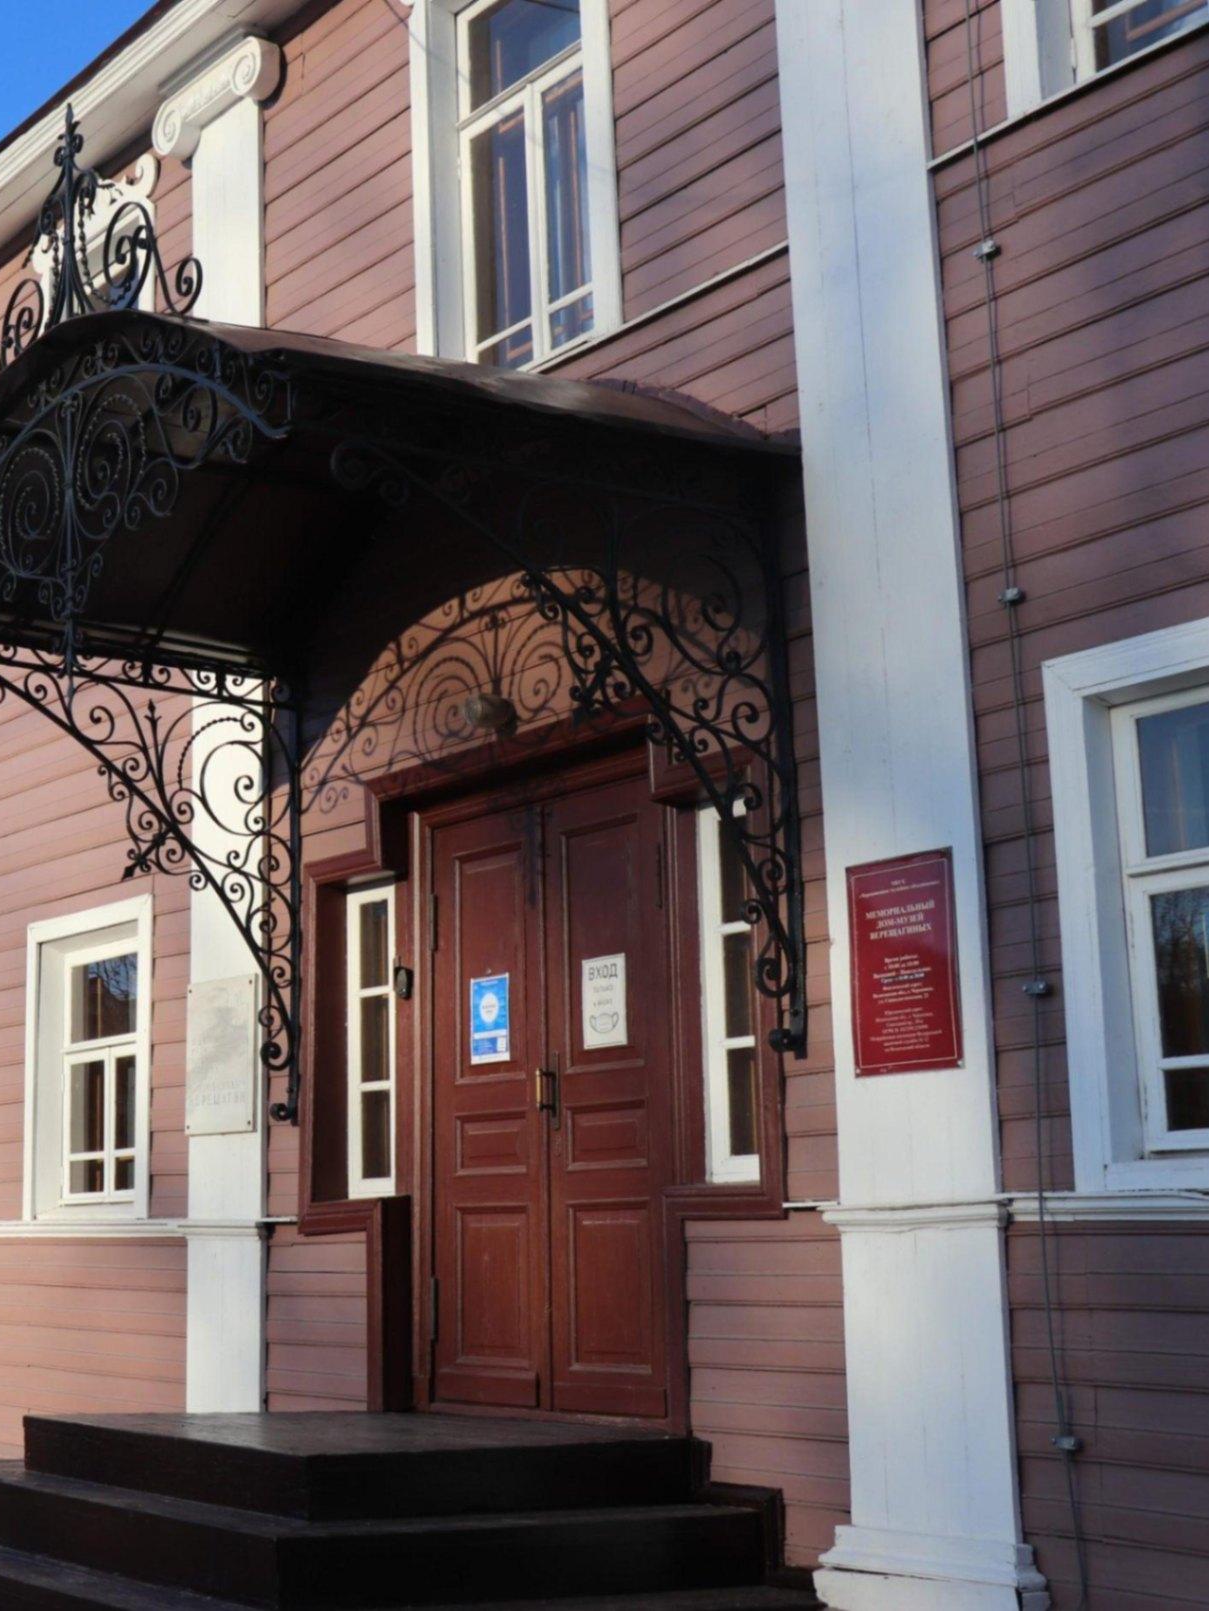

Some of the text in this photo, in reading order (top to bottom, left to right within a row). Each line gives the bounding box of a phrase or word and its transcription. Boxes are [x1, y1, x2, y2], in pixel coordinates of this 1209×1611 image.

[865, 899, 935, 920] МЕМОРИАЛЬНЫЙ
[876, 912, 924, 929] ДОМ-МУЗЕЙ
[870, 922, 932, 940] ВЕРЕЩАГИНЫХ
[588, 963, 618, 981] ВХОД
